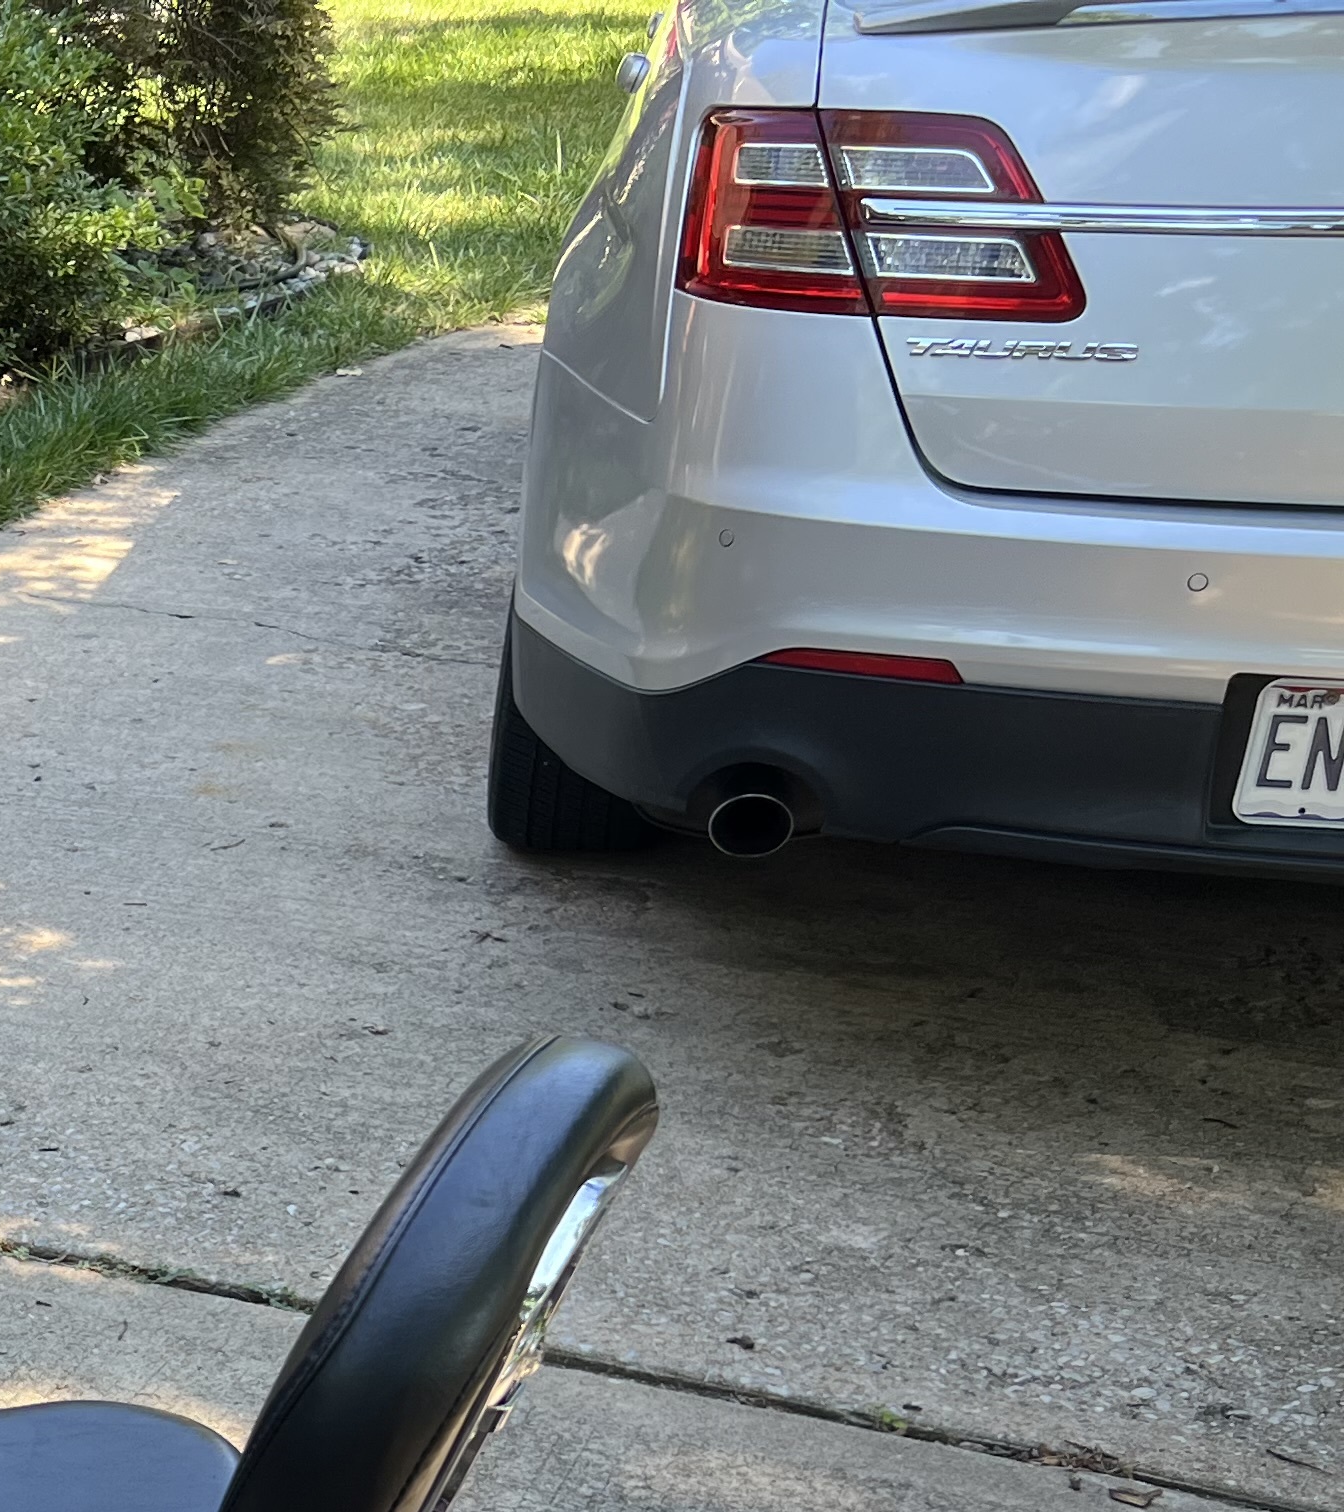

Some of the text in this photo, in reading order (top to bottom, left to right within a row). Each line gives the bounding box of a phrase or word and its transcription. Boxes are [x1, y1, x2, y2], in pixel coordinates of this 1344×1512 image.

[906, 336, 1140, 362] TAURUS
[1276, 693, 1324, 710] MAR
[1255, 714, 1344, 792] EN
